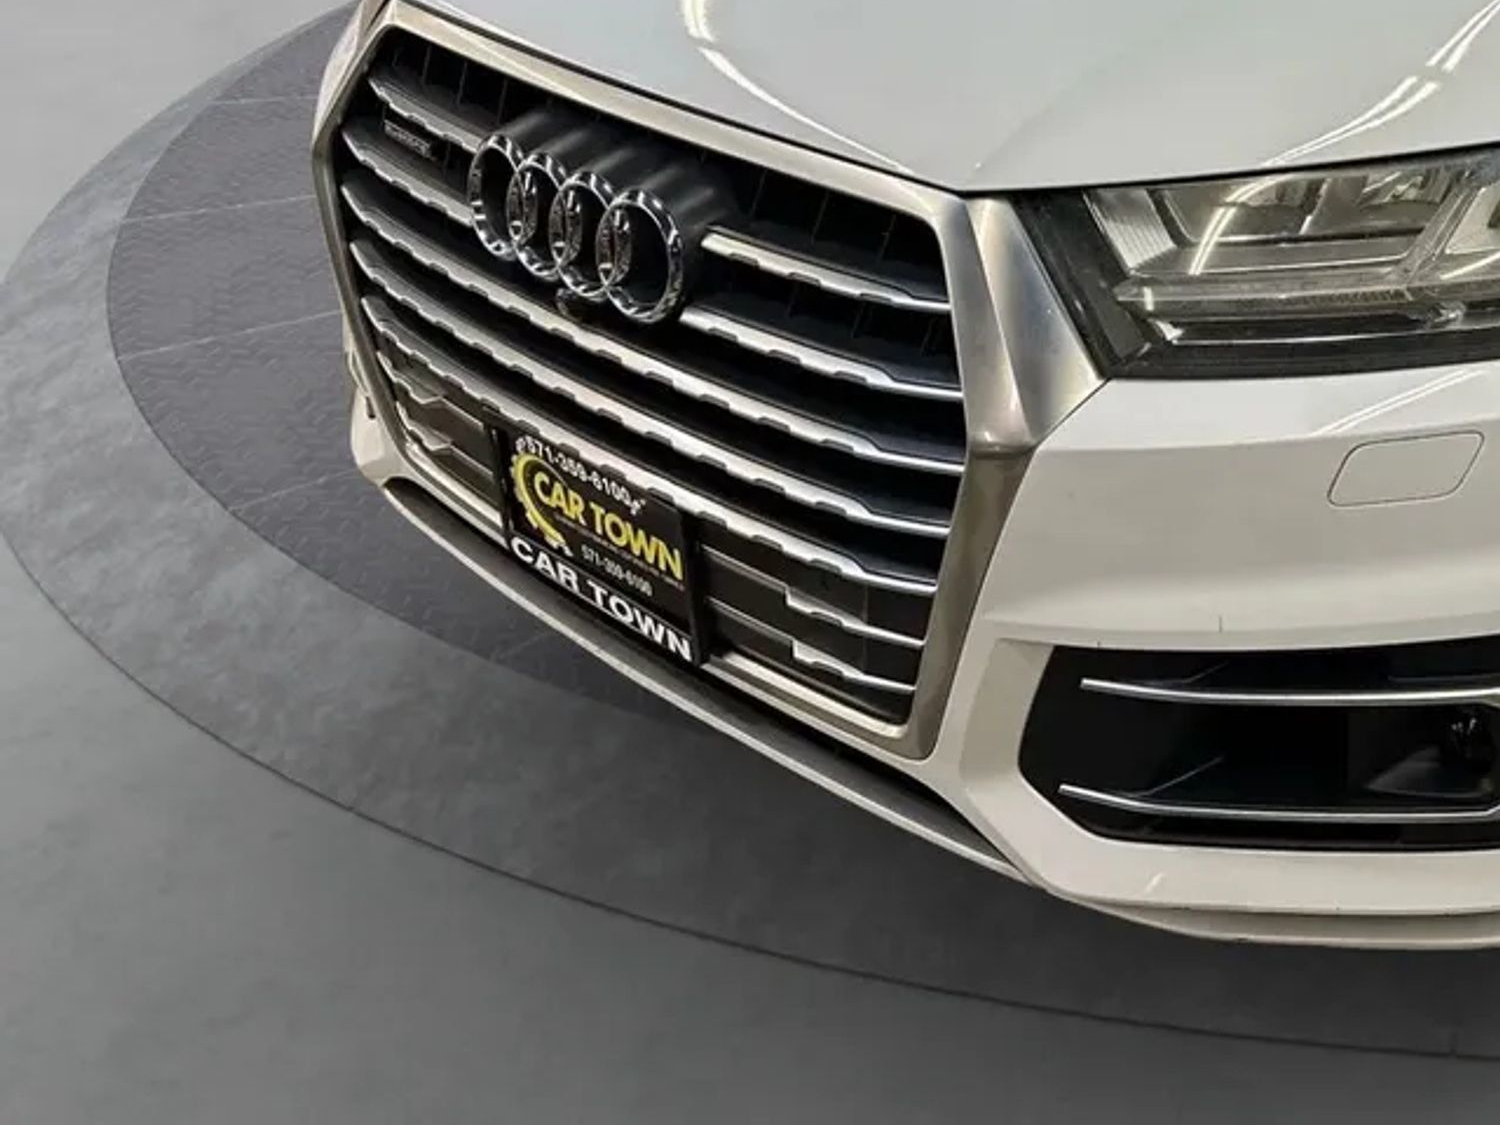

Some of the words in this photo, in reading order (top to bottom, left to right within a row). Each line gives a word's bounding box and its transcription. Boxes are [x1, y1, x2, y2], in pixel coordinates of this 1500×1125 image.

[534, 471, 587, 525] CAR
[590, 502, 684, 580] TOWN
[511, 536, 582, 597] CAR
[588, 580, 693, 662] TOWN
